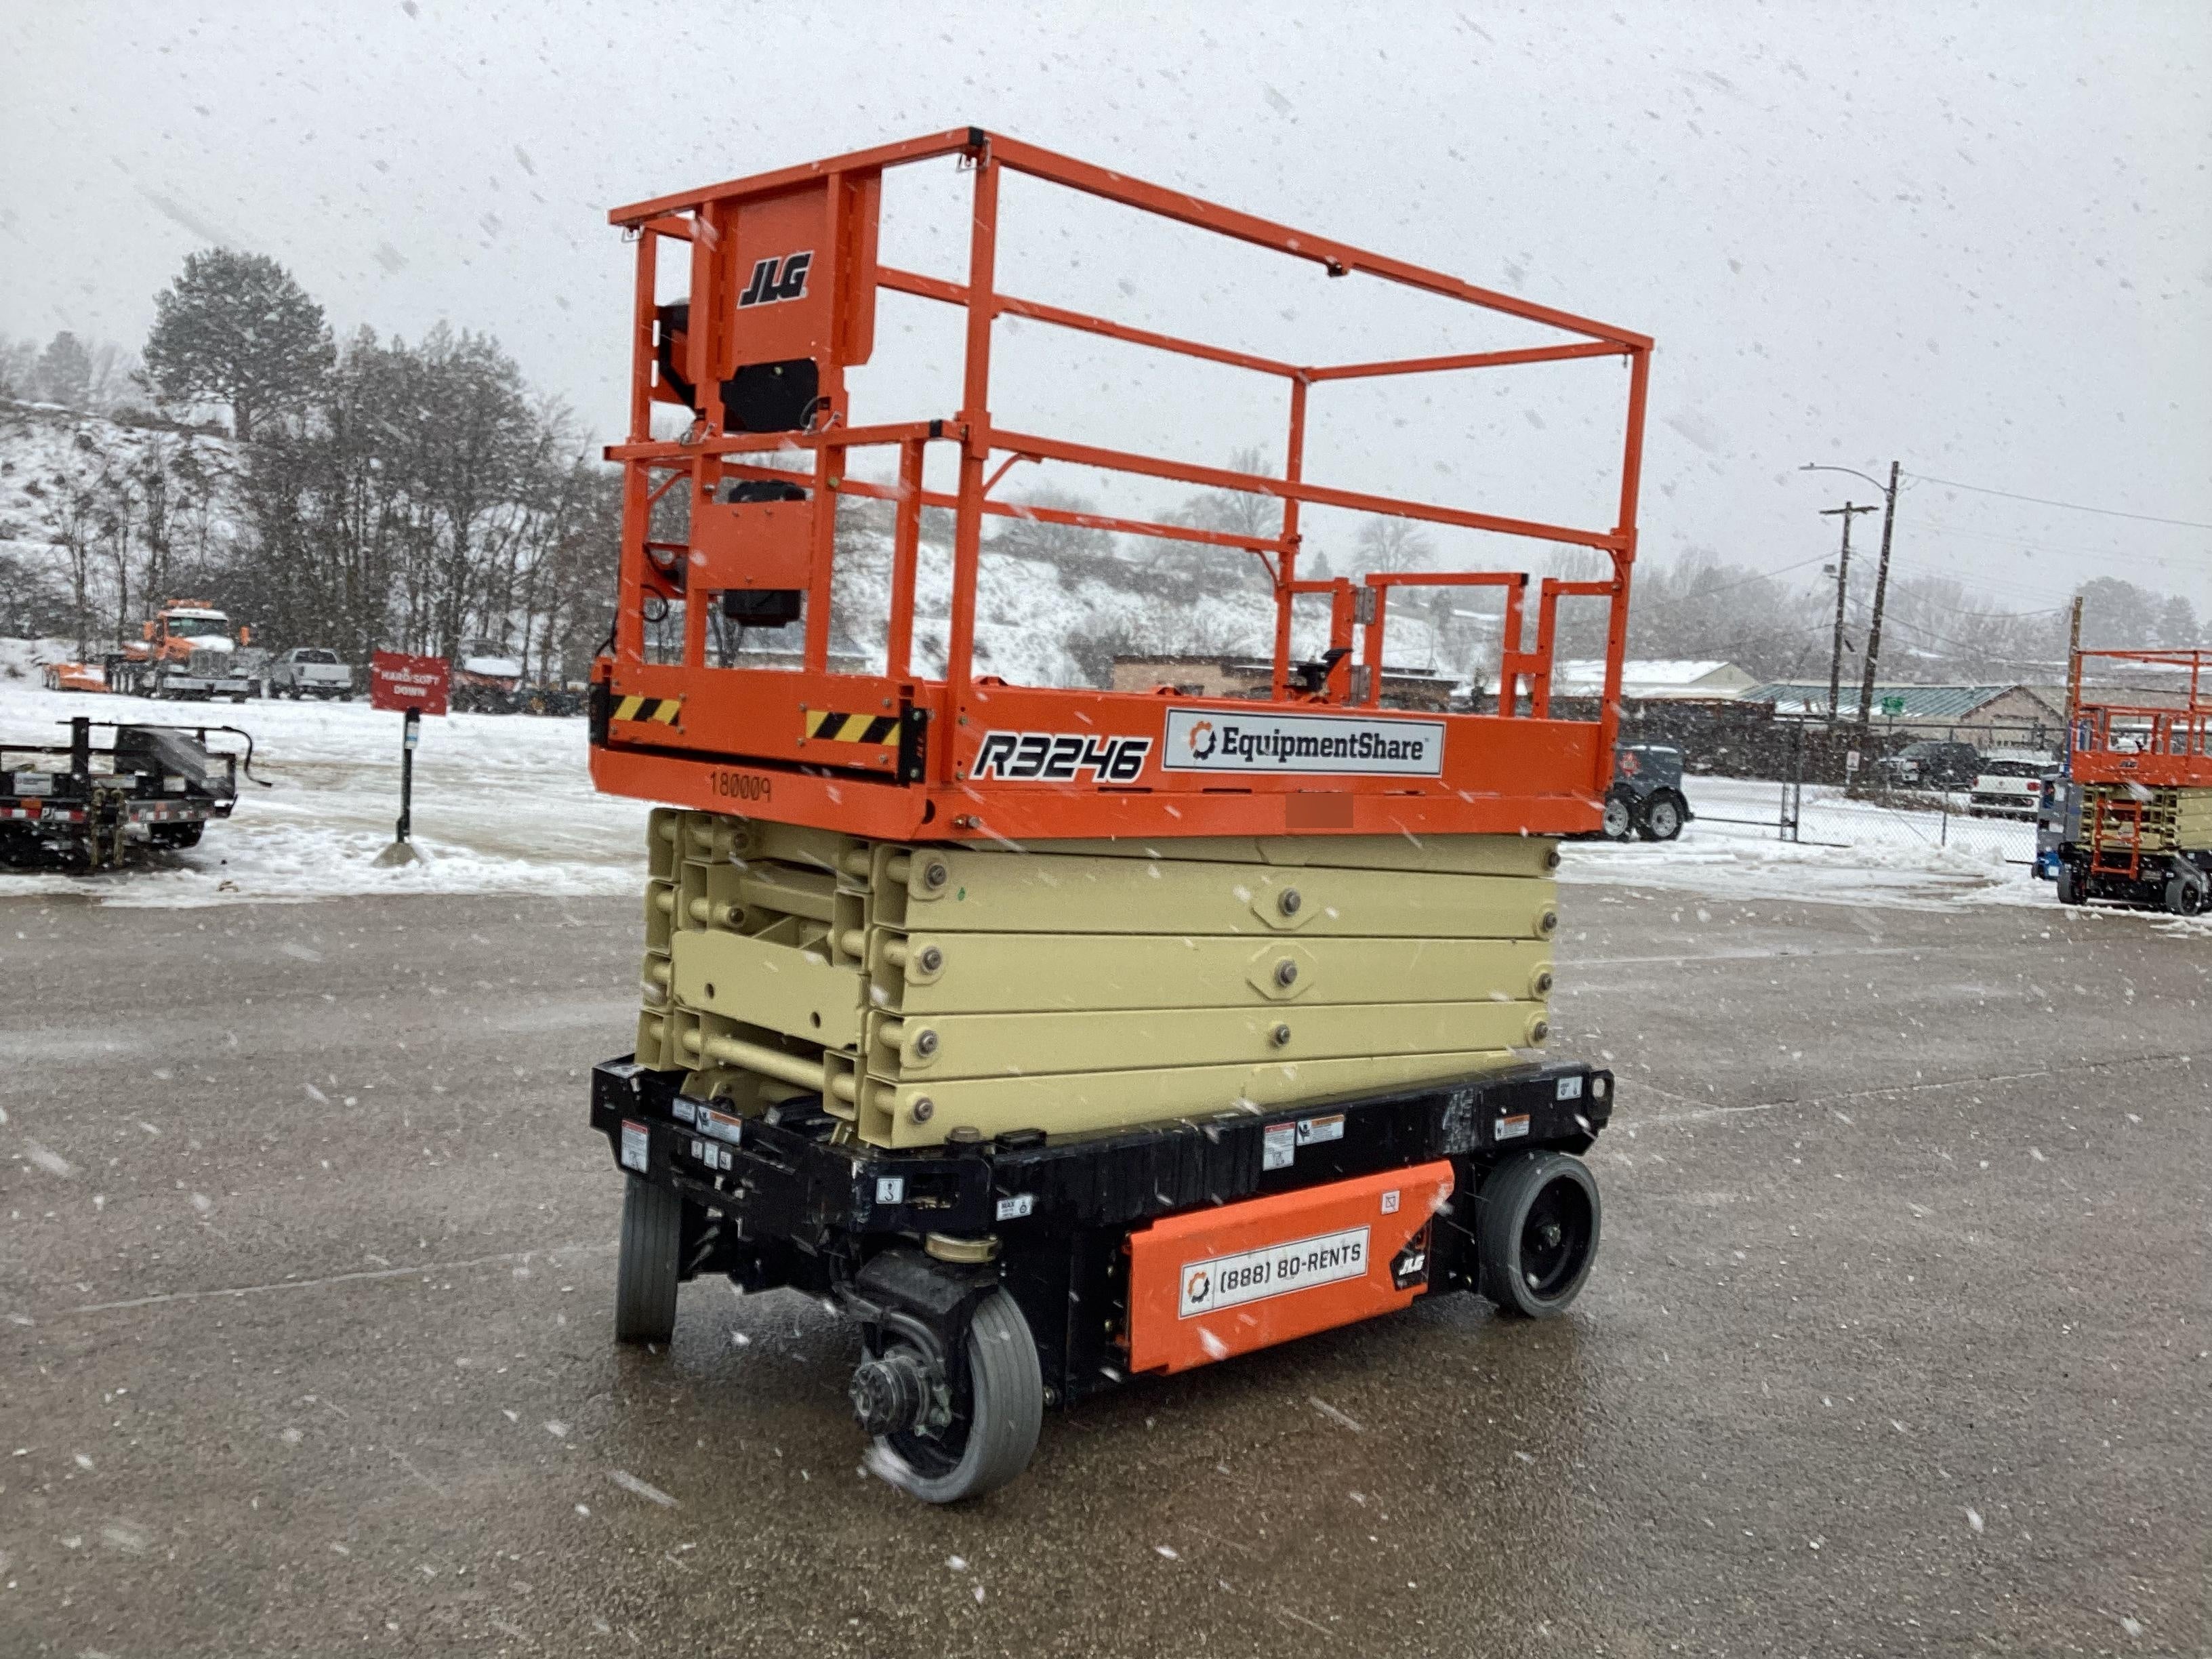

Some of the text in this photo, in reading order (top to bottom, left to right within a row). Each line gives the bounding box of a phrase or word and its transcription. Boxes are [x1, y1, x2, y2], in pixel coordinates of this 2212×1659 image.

[737, 251, 813, 308] JLG
[394, 684, 427, 697] DOWN
[972, 732, 1151, 781] R3246
[1221, 726, 1424, 763] EquipmentShare
[710, 771, 771, 802] 180009
[1221, 1243, 1361, 1294] (888) 80-RENTS
[1399, 1254, 1426, 1275] JLG
